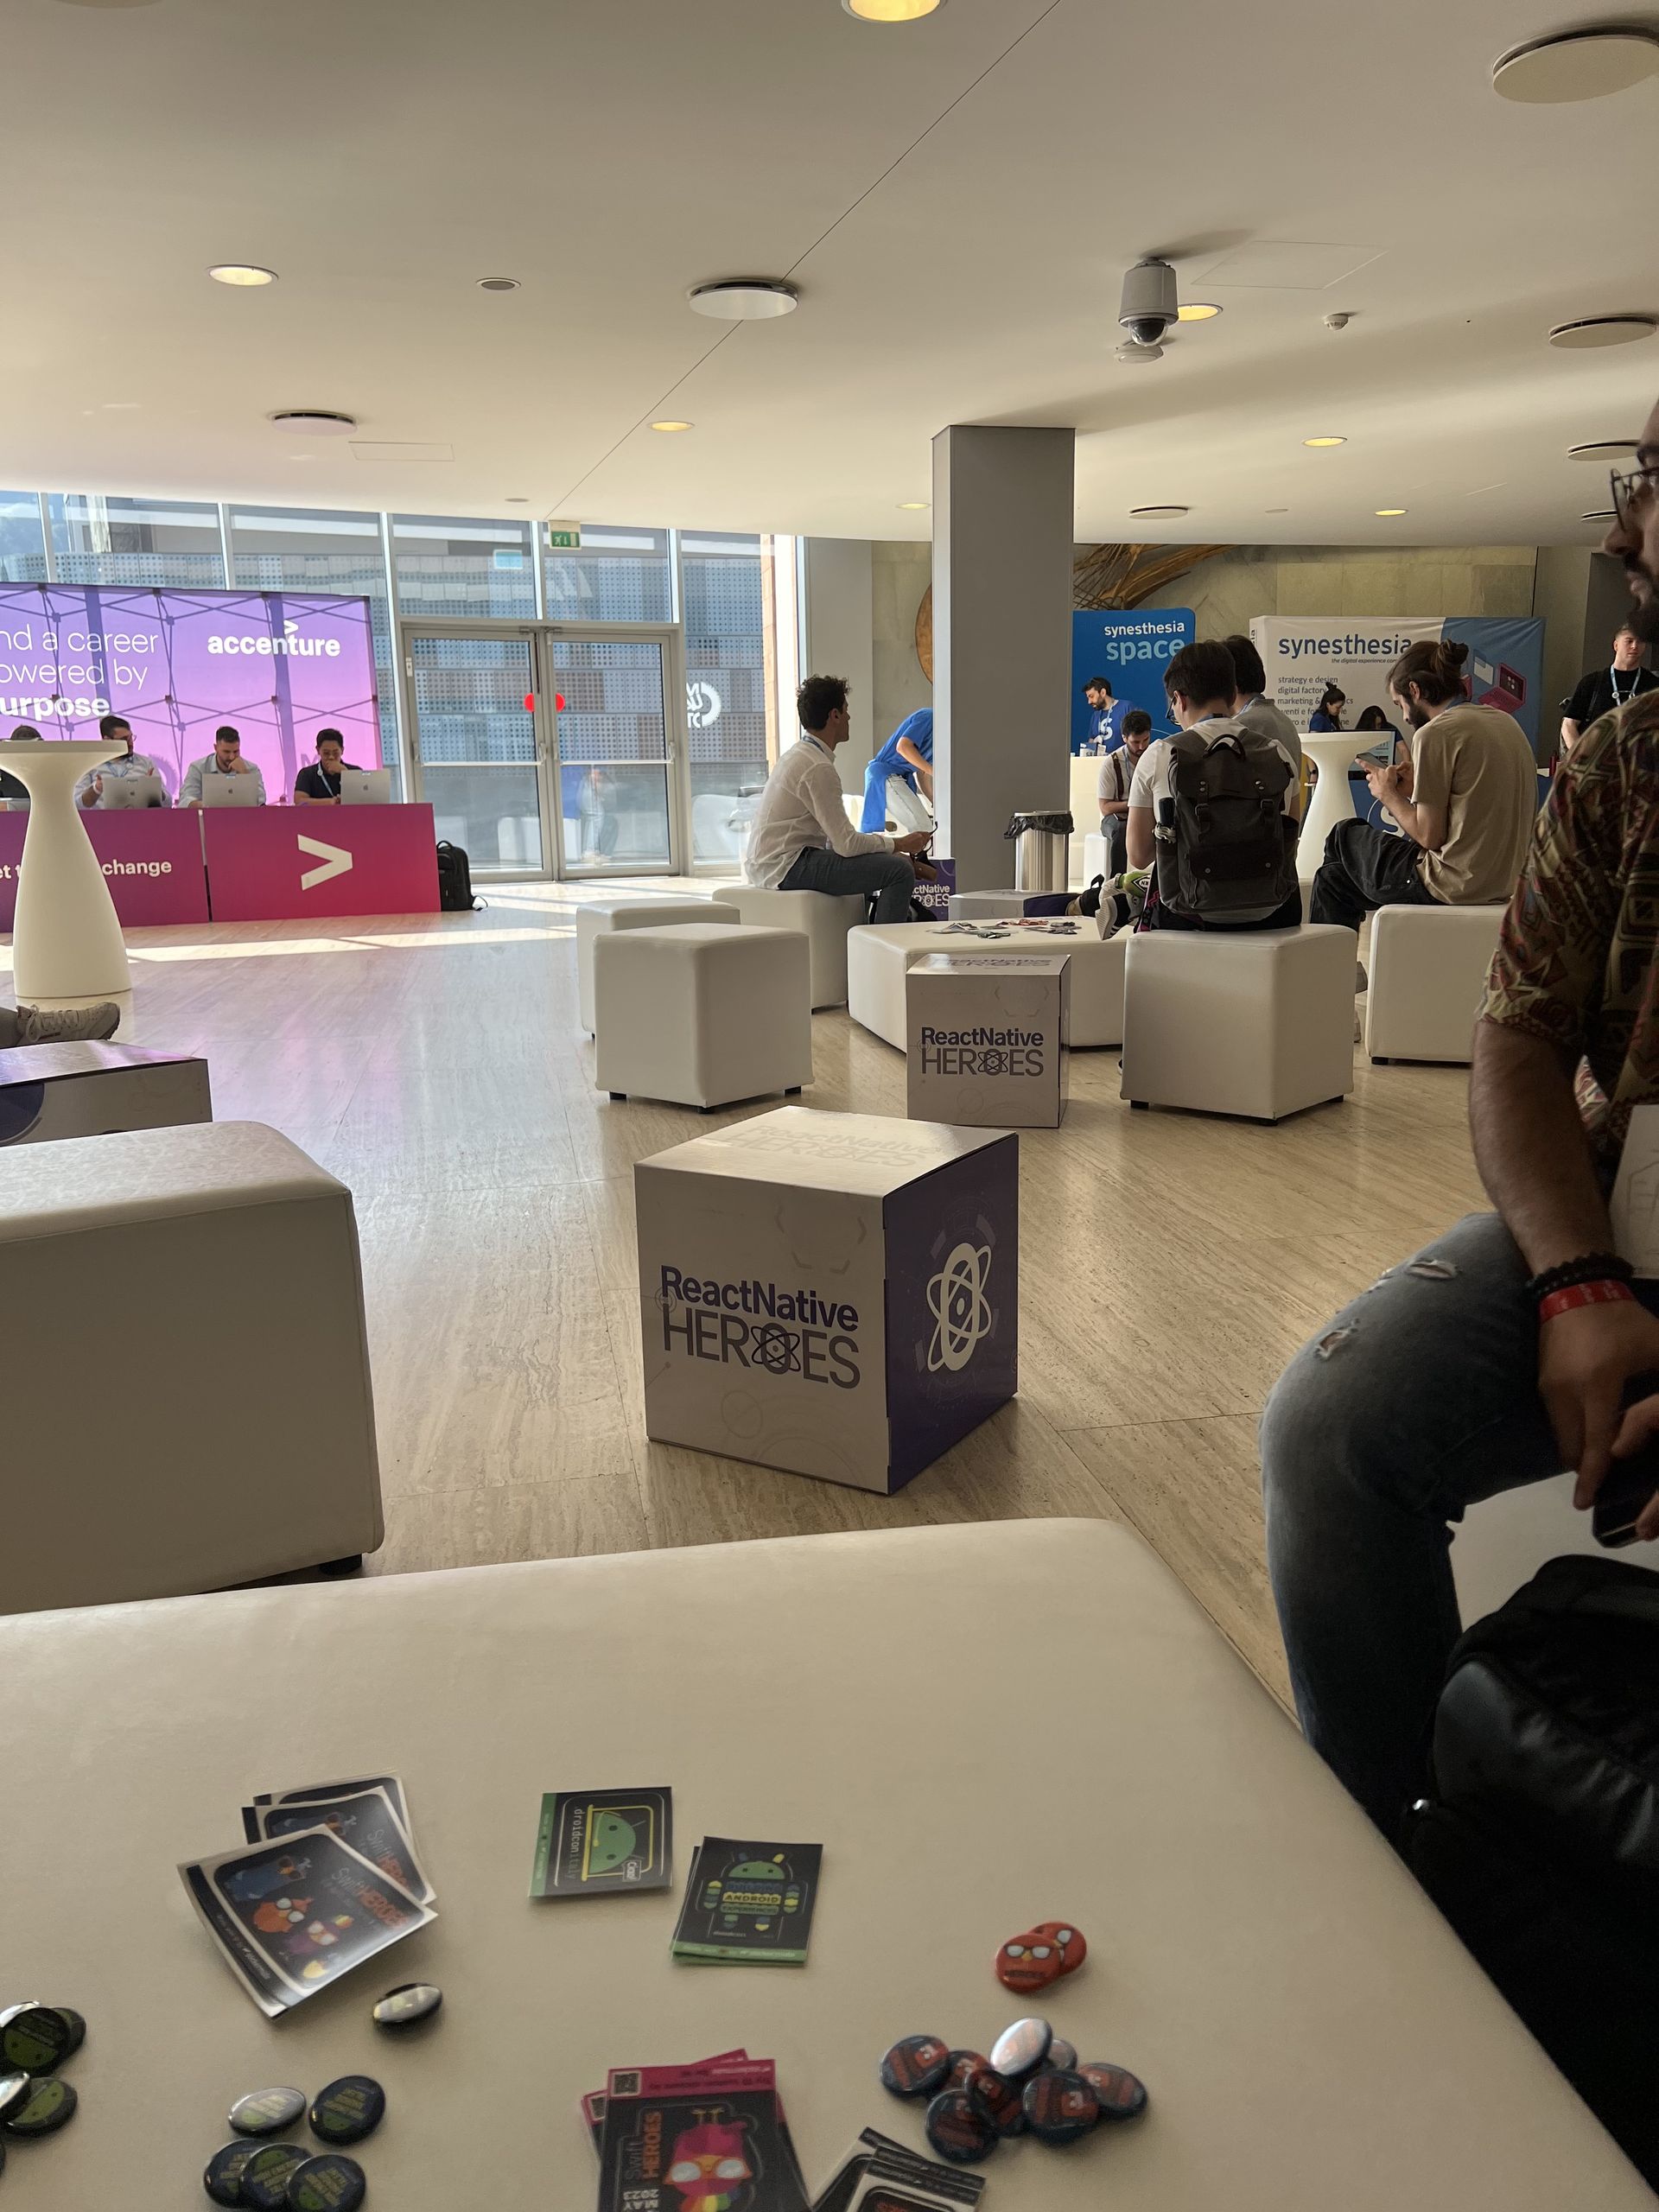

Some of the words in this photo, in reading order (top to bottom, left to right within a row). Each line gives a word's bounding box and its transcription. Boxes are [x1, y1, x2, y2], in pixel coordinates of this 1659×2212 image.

[1104, 620, 1185, 638] synesthesia
[42, 631, 59, 651] a
[67, 632, 159, 653] career
[207, 635, 341, 657] accenture
[1106, 639, 1185, 666] space
[113, 658, 149, 690] by
[1278, 677, 1307, 685] strategy
[1314, 676, 1338, 685] design
[1277, 686, 1300, 696] digital
[1277, 697, 1313, 706] marketing
[102, 860, 172, 877] change
[921, 1027, 1044, 1047] ReactNative
[921, 1048, 1045, 1077] HEROES
[661, 1265, 859, 1332] ReactNative
[662, 1302, 861, 1389] HEROES
[724, 1892, 779, 1904] ANDROID
[642, 2110, 662, 2179] HEROES
[622, 2189, 659, 2201] 2023
